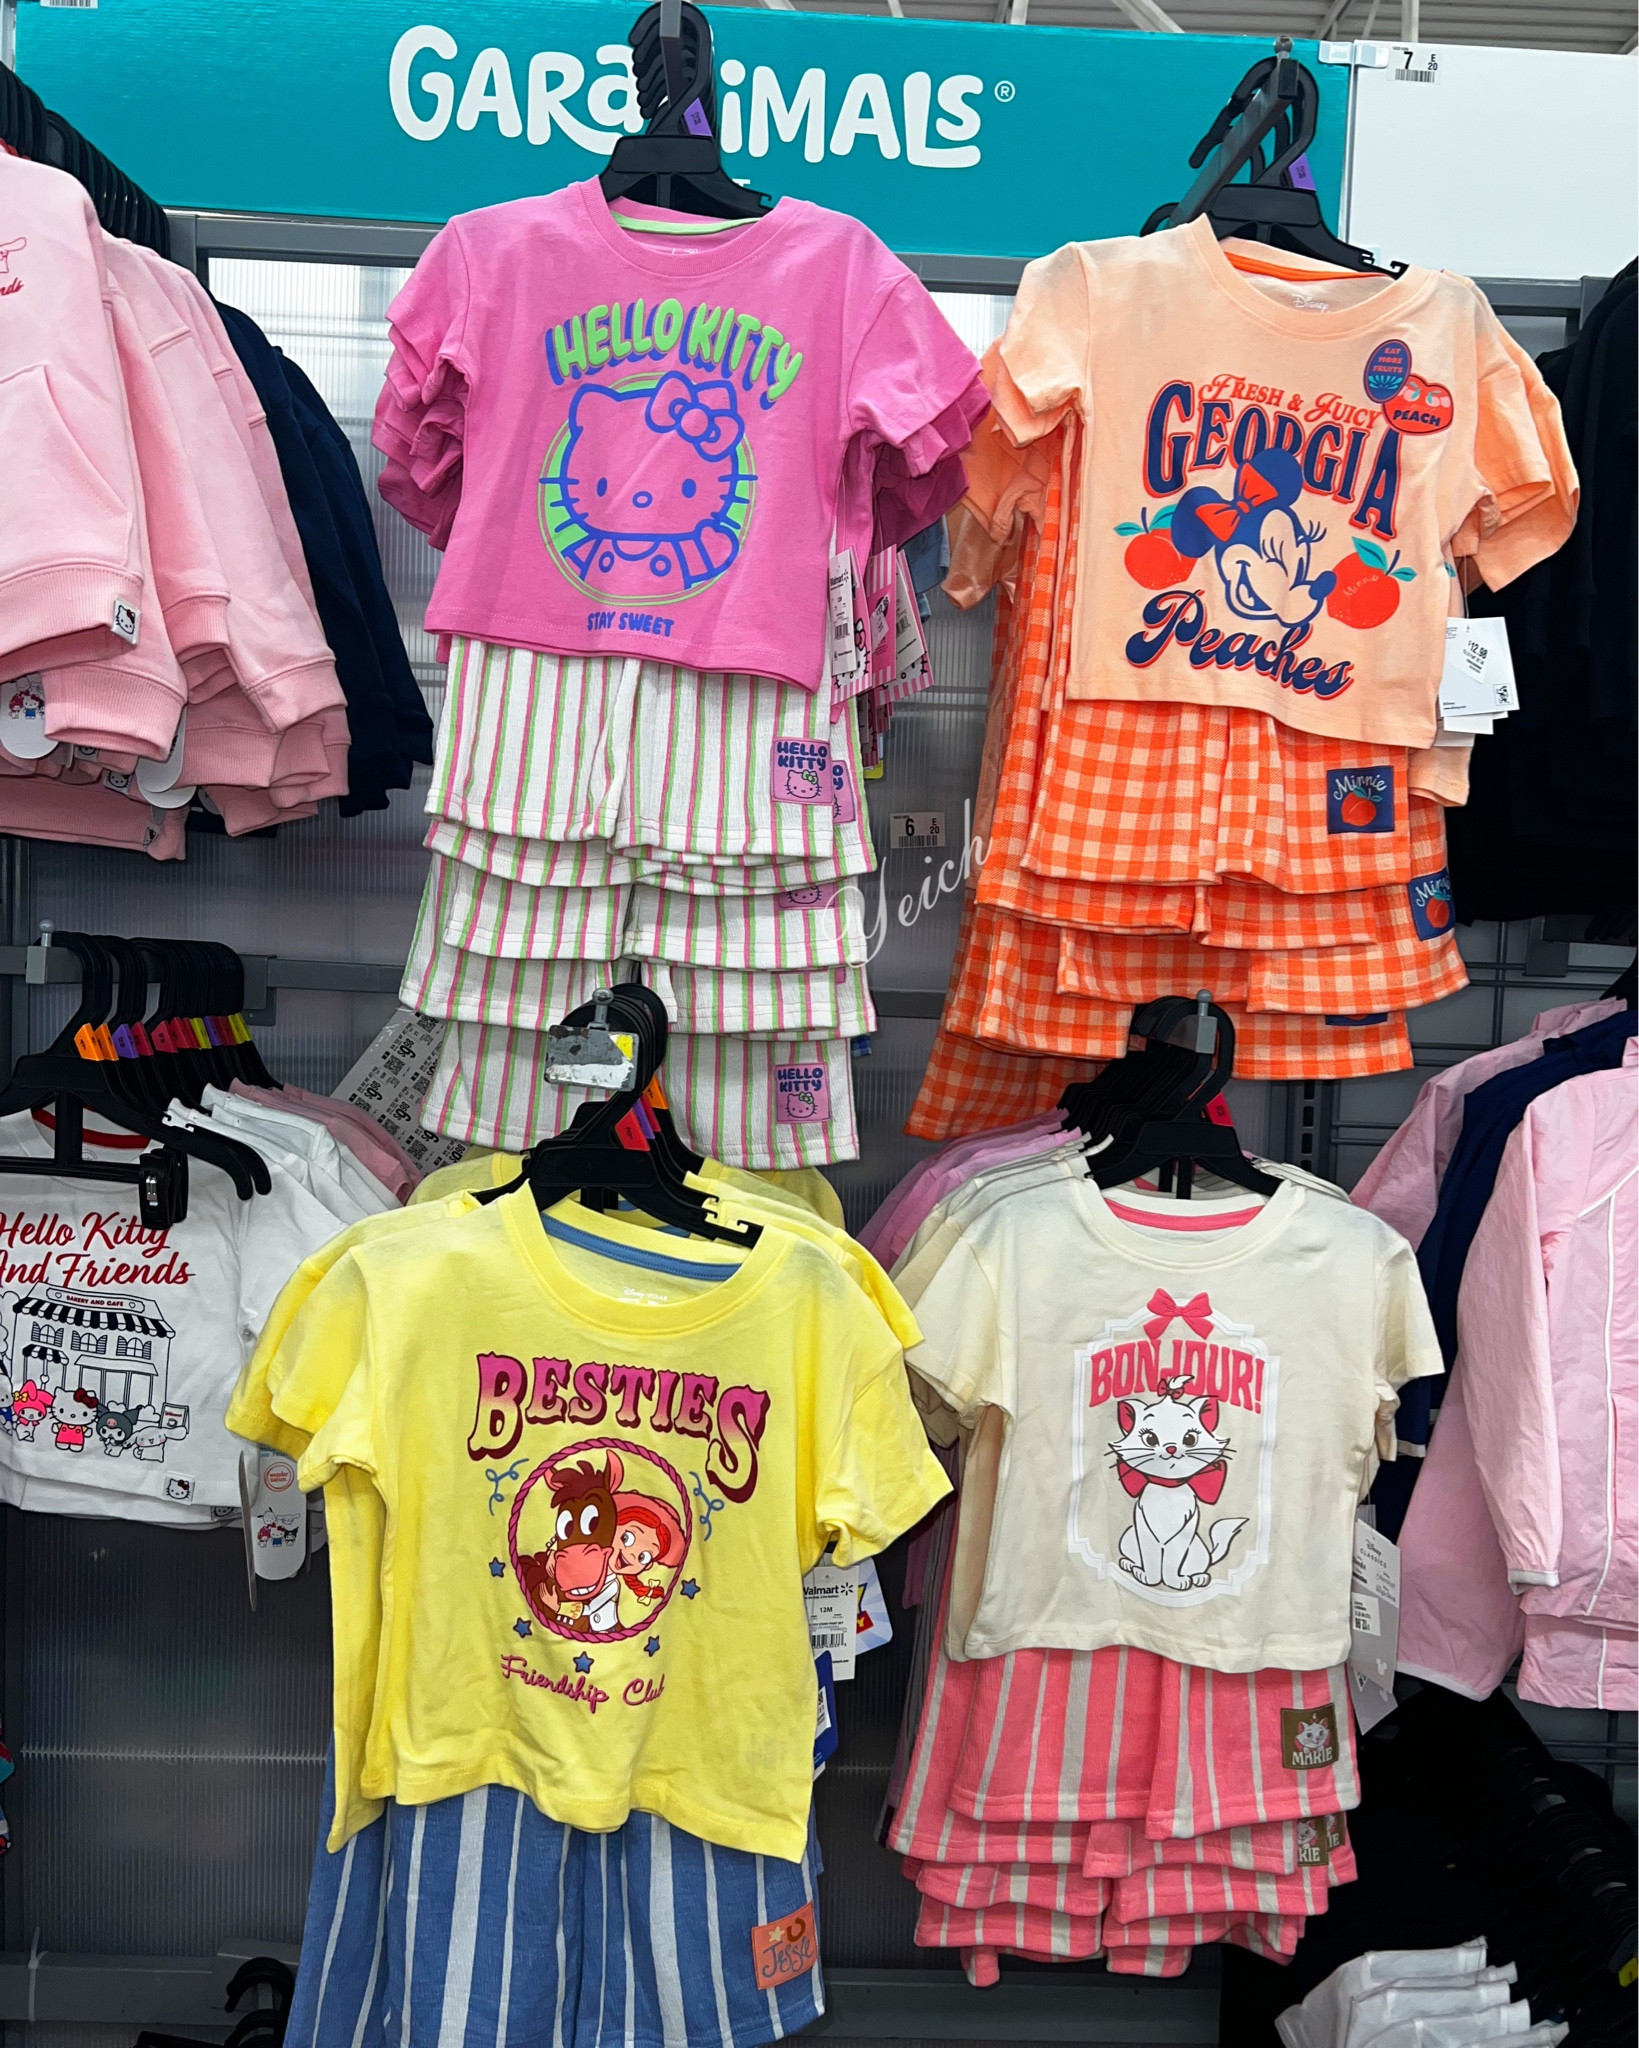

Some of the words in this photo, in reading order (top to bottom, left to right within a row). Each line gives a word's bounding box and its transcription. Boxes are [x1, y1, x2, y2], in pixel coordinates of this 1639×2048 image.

[1404, 51, 1413, 70] 7
[1428, 62, 1438, 71] 20
[1431, 54, 1436, 62] E
[545, 298, 684, 385] HELLO
[679, 302, 803, 410] KITTY
[1373, 365, 1403, 373] FRUITS
[1198, 373, 1285, 406] FRESH
[1287, 394, 1304, 411] &
[1303, 392, 1383, 429] JUICY
[1143, 379, 1403, 541] GEORGIA
[587, 612, 616, 631] STAY
[619, 612, 675, 637] SWEET
[1125, 589, 1354, 700] Peaches
[777, 741, 828, 757] HELLO
[778, 755, 826, 771] KITTY
[1333, 774, 1387, 800] Minnie
[905, 818, 915, 836] 6
[930, 826, 940, 834] 20
[932, 818, 937, 826] E
[778, 1068, 823, 1080] HELLO
[780, 1079, 822, 1092] KITTY
[0, 1211, 76, 1249] Hello
[81, 1211, 170, 1258] Kitty
[55, 1251, 196, 1288] Friends
[66, 1295, 89, 1304] BAKERY
[1089, 1339, 1265, 1414] BONJOUR!
[467, 1351, 771, 1503] BESTIES
[500, 1654, 609, 1714] Friendship
[1292, 1747, 1333, 1766] MARIE
[1298, 1847, 1320, 1862] RIE
